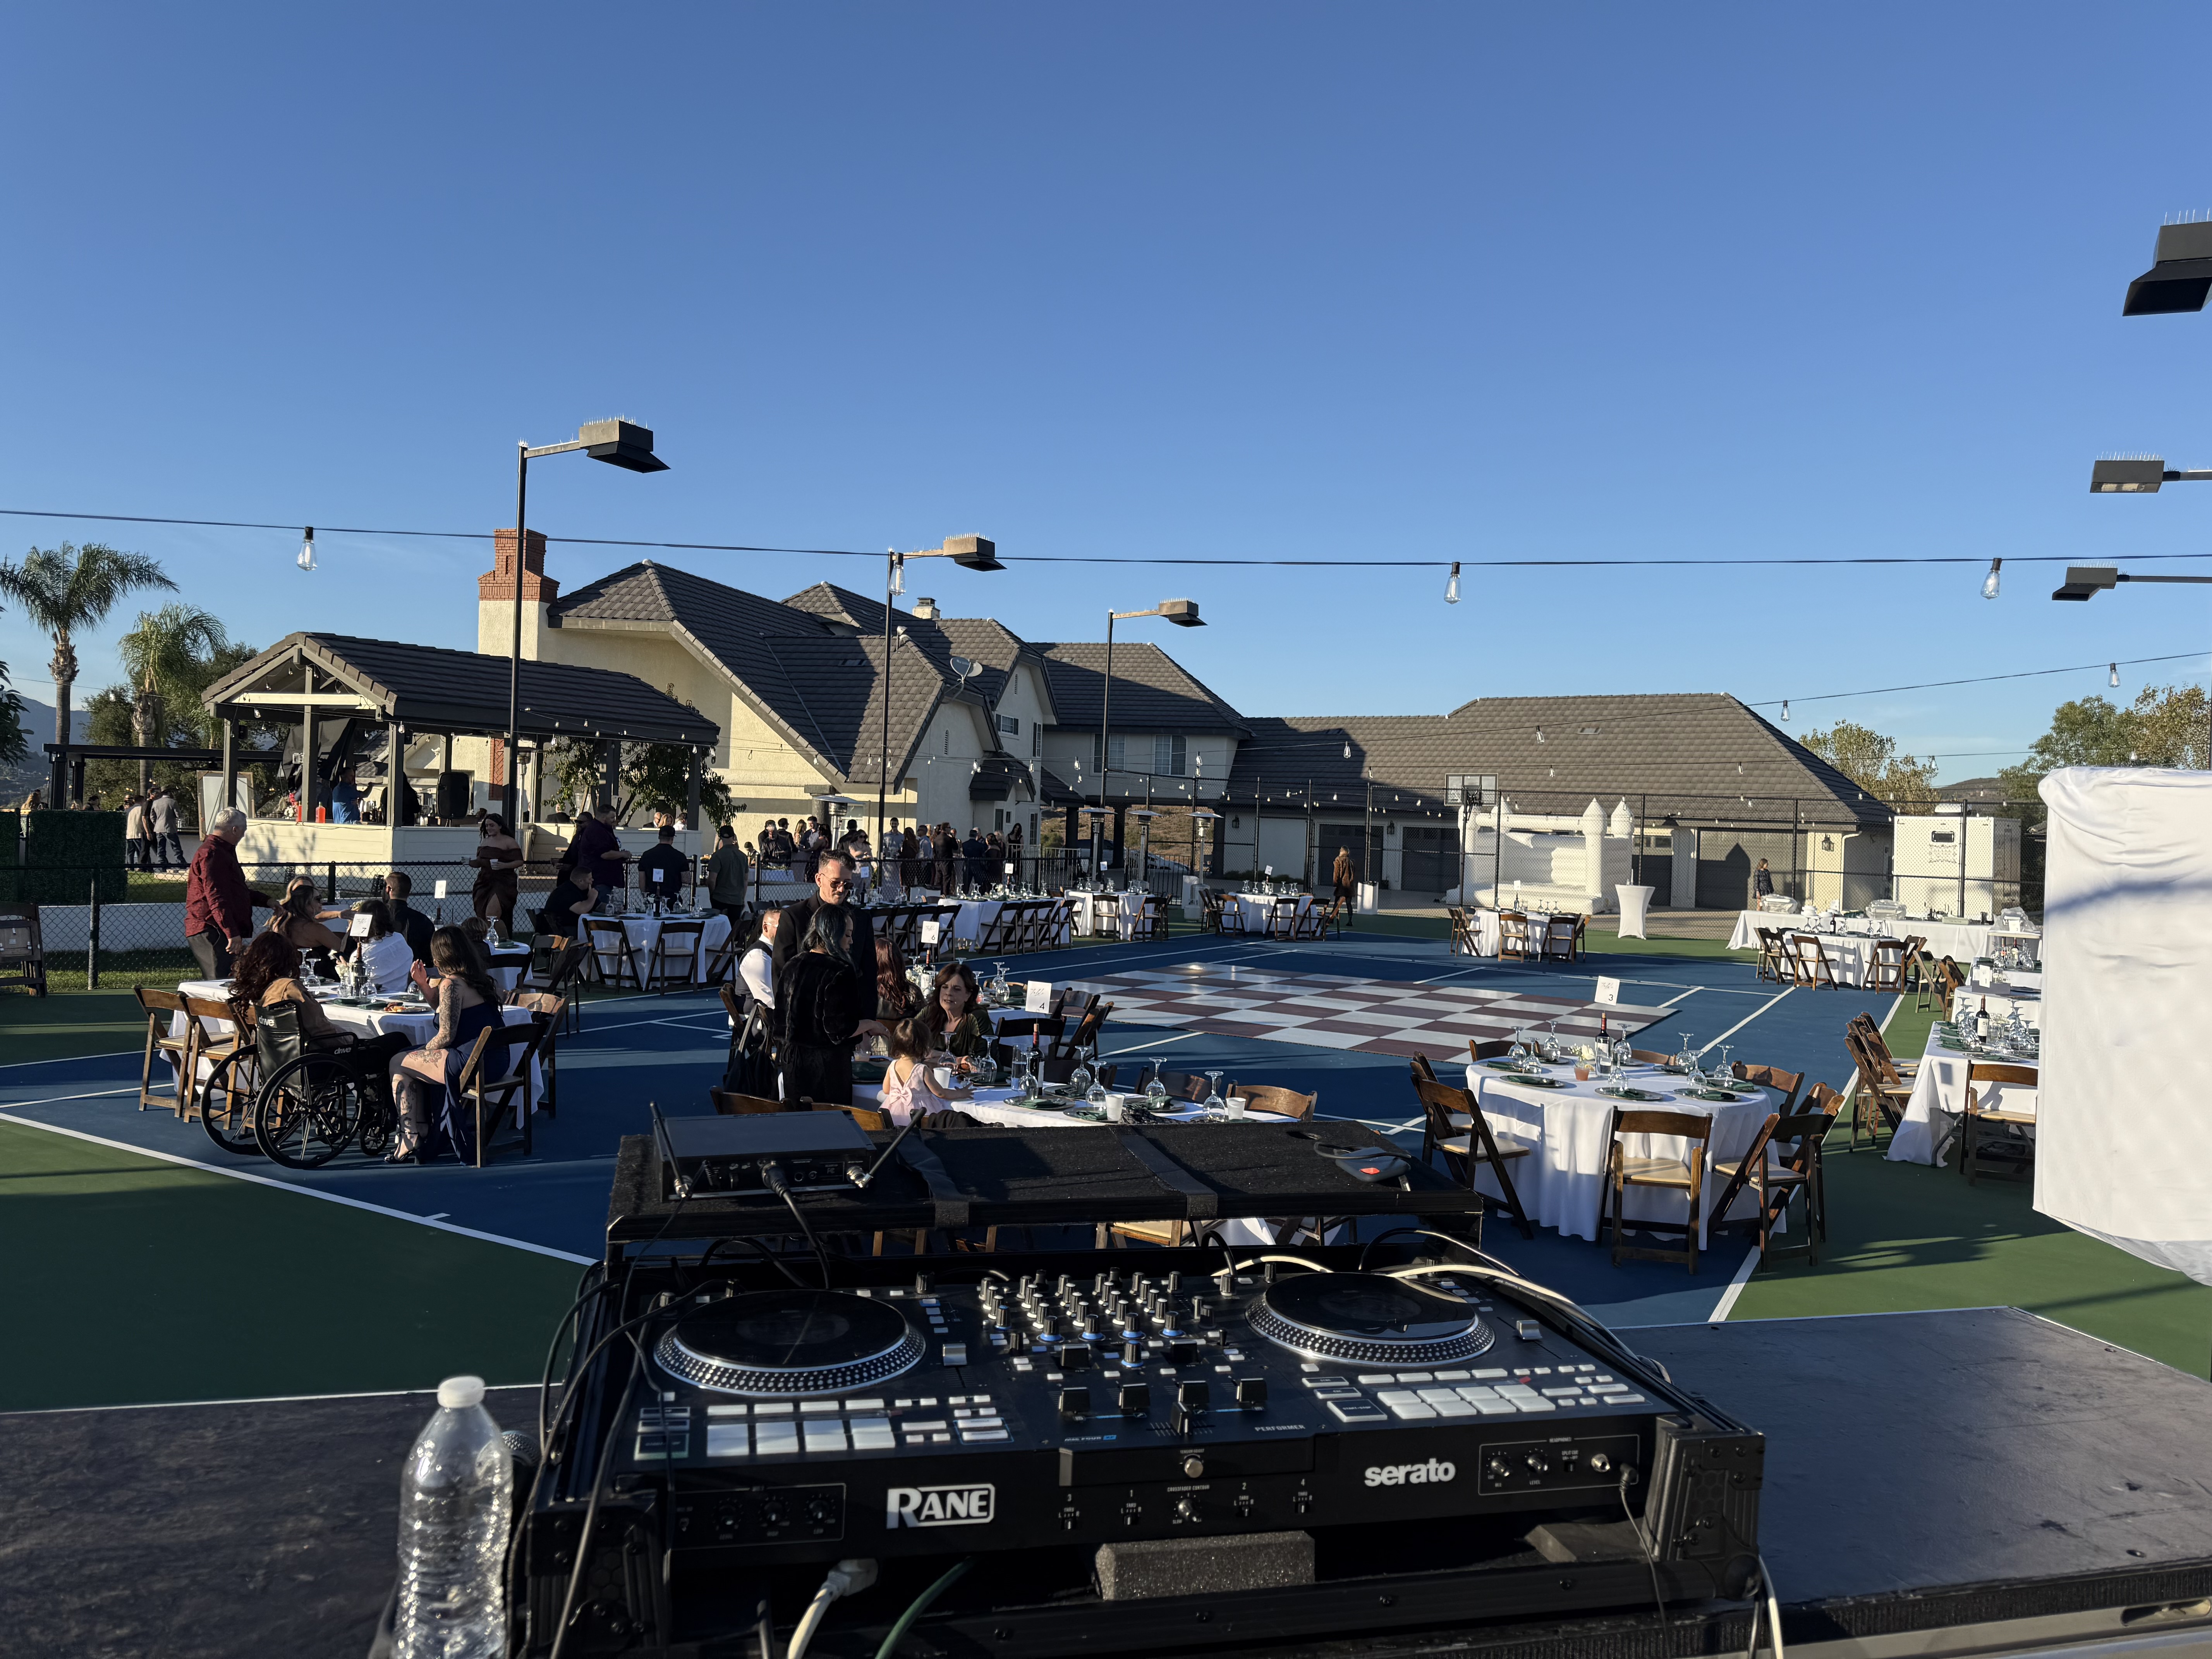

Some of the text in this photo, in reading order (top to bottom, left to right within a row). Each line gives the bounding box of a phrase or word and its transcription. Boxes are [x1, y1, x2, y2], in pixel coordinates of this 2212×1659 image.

[1254, 1424, 1305, 1432] PERFORMER
[1364, 1458, 1456, 1487] serato
[1242, 1482, 1247, 1490] 2
[1067, 1494, 1072, 1502] 3
[886, 1487, 989, 1529] RANE
